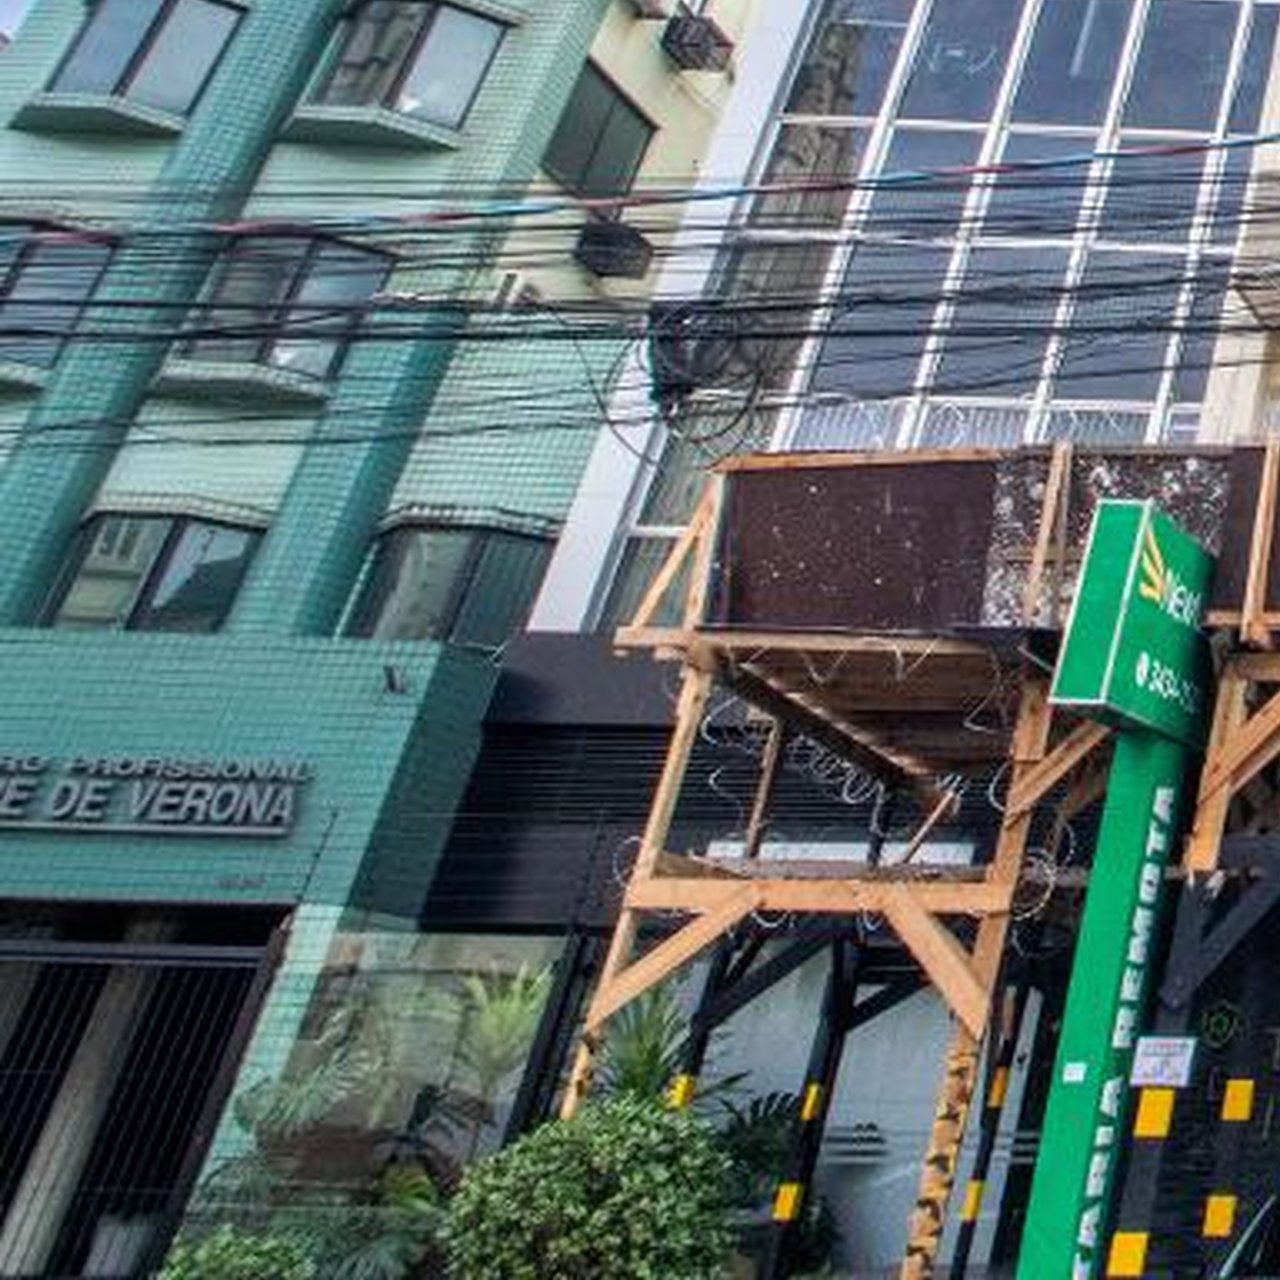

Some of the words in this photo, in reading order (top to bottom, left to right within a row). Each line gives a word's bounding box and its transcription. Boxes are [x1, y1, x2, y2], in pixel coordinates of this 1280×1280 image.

[69, 756, 309, 784] PROFISSIONAL
[51, 777, 113, 819] DE
[129, 780, 297, 823] VERONA
